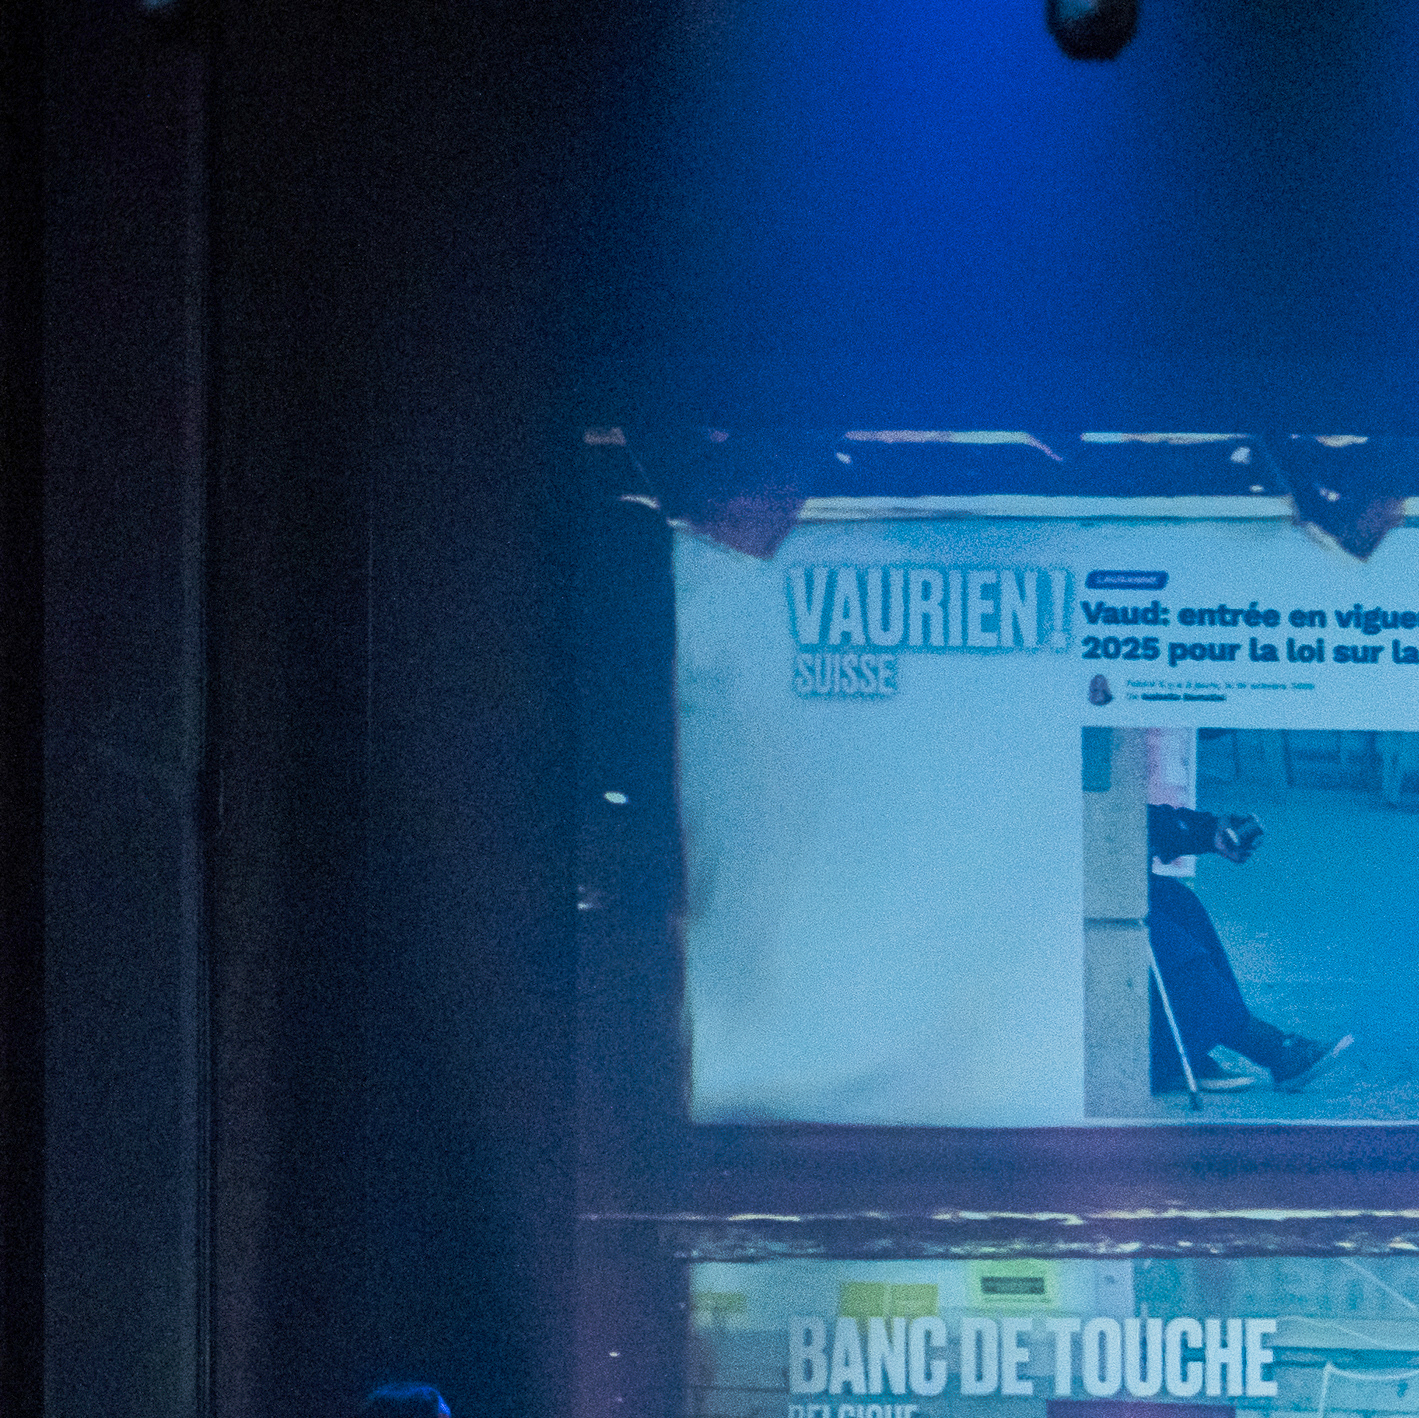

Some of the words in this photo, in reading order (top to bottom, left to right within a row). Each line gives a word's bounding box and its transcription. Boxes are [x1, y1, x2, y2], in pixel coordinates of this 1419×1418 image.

[788, 566, 1038, 648] VAURIEN
[1080, 600, 1170, 626] Vaud:
[1177, 601, 1281, 628] entrée
[1288, 609, 1327, 629] en
[1081, 635, 1161, 660] 2025
[1168, 642, 1242, 668] pour
[1249, 637, 1280, 663] la
[1286, 637, 1325, 663] loi
[1333, 644, 1385, 664] sur
[797, 653, 899, 693] SUISSE
[788, 1316, 947, 1396] BANC
[960, 1317, 1034, 1396] DE
[1046, 1316, 1279, 1397] TOUCHE
